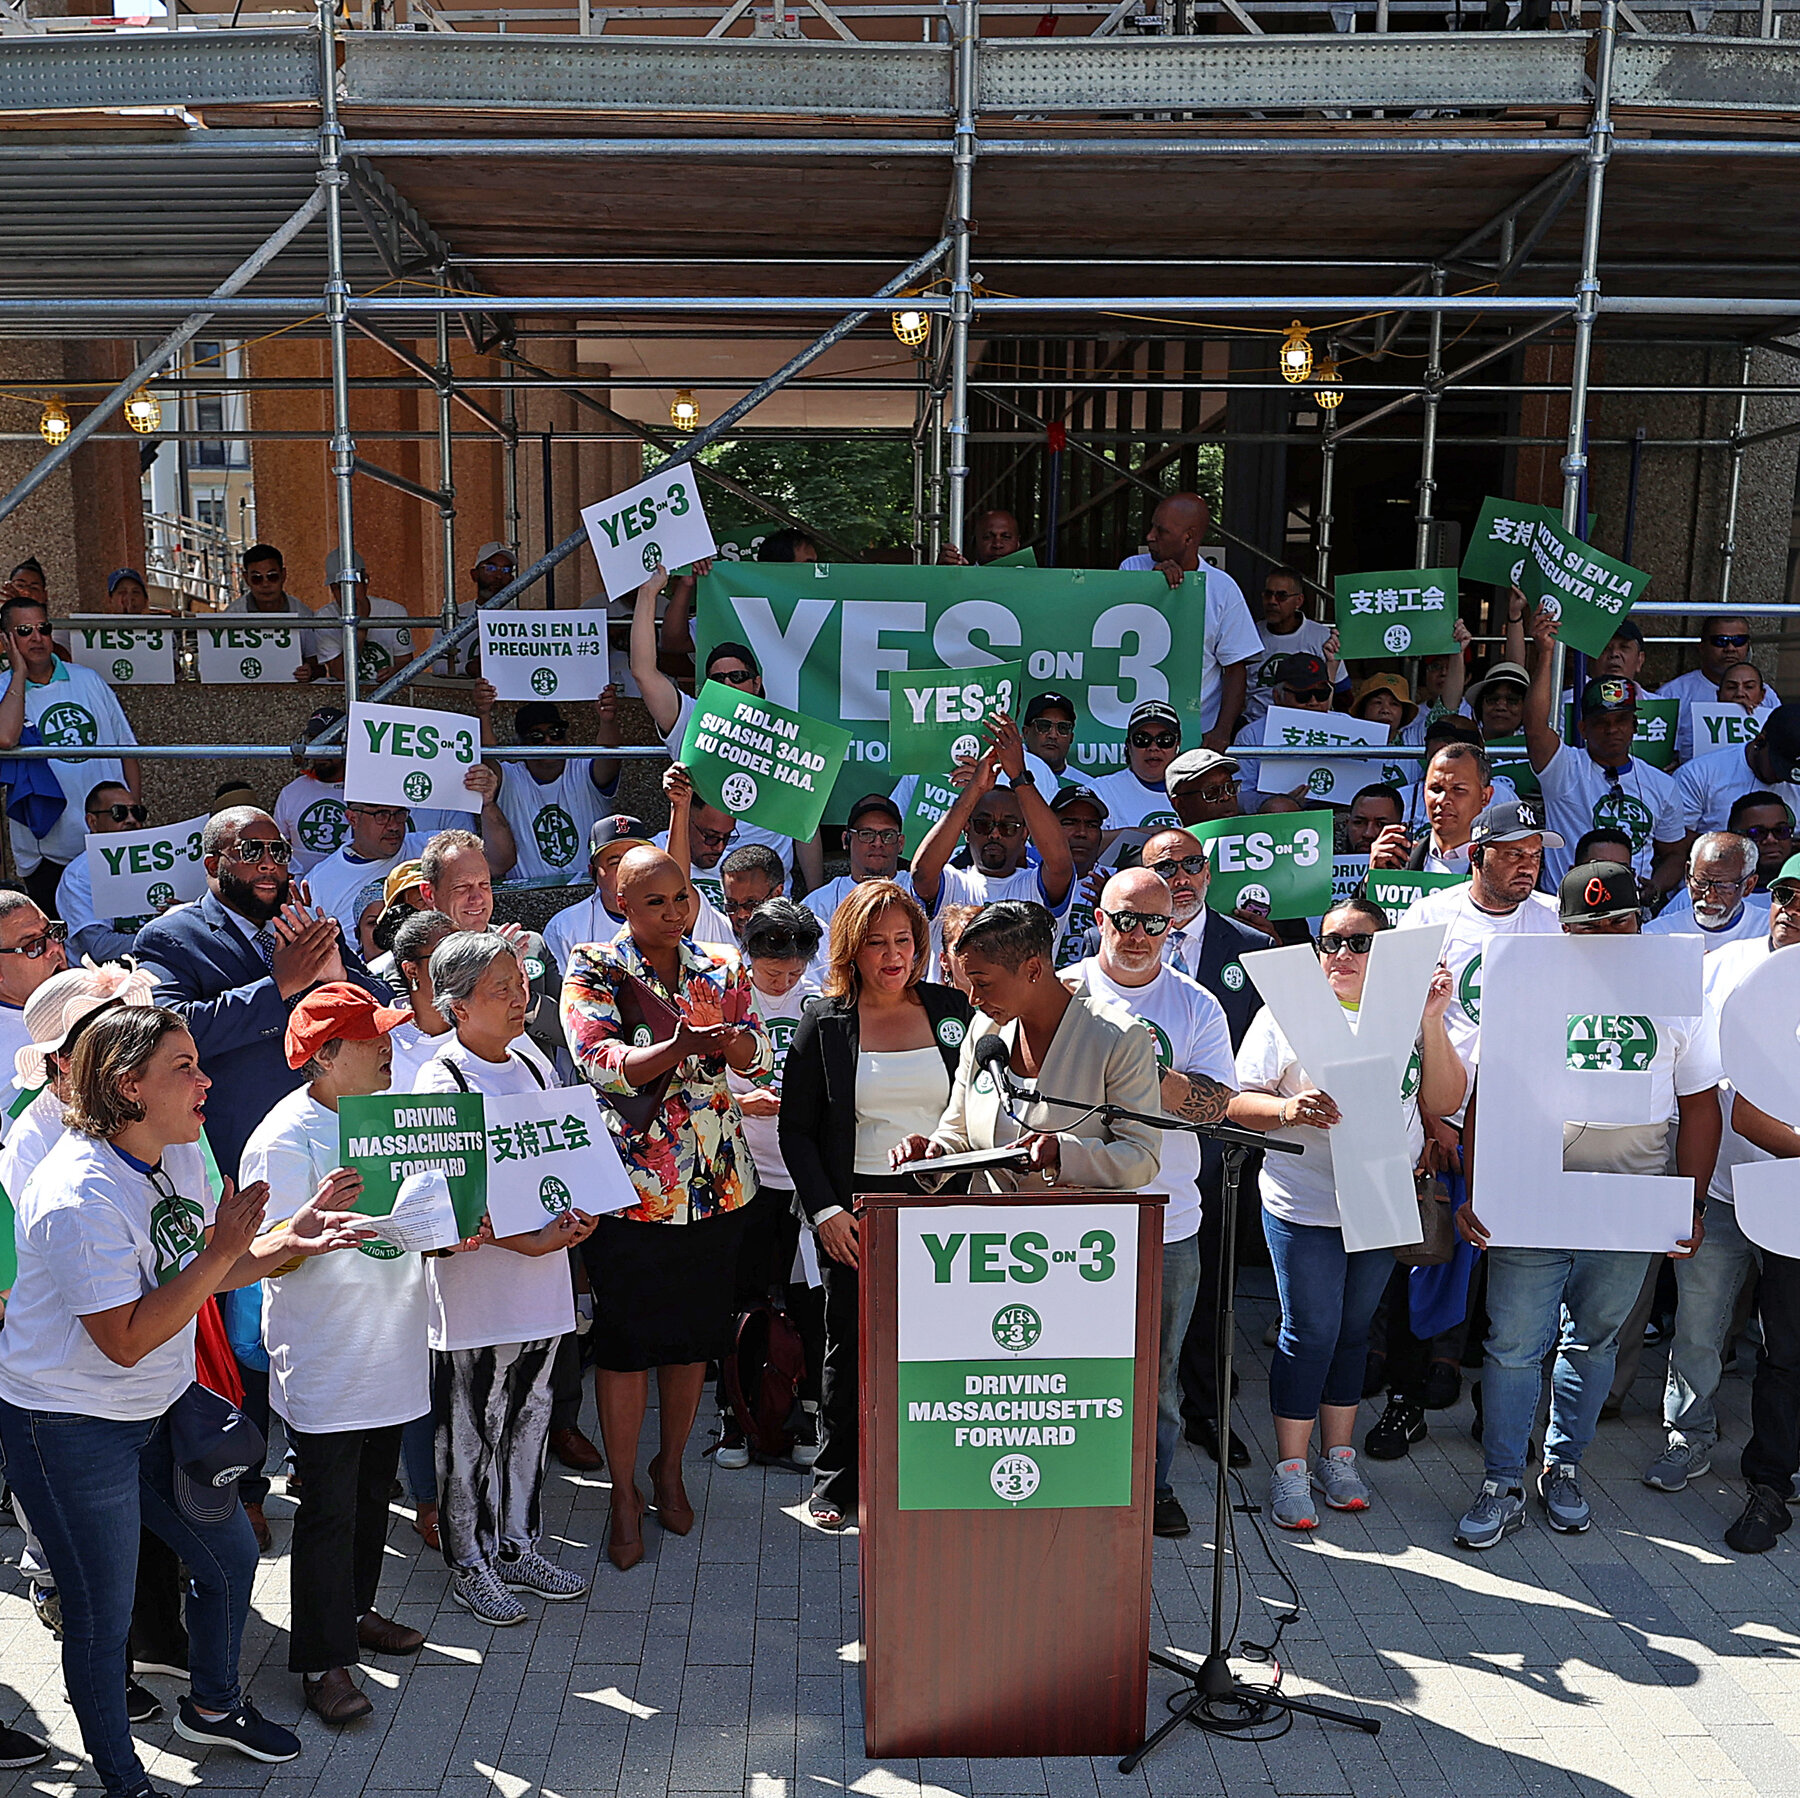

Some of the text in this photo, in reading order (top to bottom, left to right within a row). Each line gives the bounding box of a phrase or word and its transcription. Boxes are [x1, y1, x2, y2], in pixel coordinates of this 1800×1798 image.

[598, 483, 690, 548] YES ON 3
[1537, 520, 1633, 597] VOTA SI EN LA
[1531, 538, 1624, 614] PREGUNTA #3
[1349, 586, 1445, 615] 支持工会
[81, 629, 135, 651] YES
[149, 629, 164, 651] 3
[207, 629, 263, 649] YES
[274, 629, 292, 649] 3
[487, 623, 599, 638] VOTA SI EN LA
[489, 641, 600, 656] PREGUNTA #3
[729, 596, 1172, 730] YES ON 3
[903, 679, 1012, 724] YES ON 3
[49, 709, 83, 731] YES
[733, 703, 800, 741] FADLAN
[1703, 716, 1760, 744] YES
[363, 720, 474, 764] YES ON 3
[695, 733, 816, 792] KU CODEE HAA.
[777, 742, 826, 773] 3AAD
[924, 782, 960, 806] VOT
[313, 806, 343, 823] YES
[1600, 799, 1642, 821] YES
[319, 823, 334, 844] 3
[612, 816, 630, 835] B
[100, 832, 203, 876] YES ON 3
[1275, 844, 1293, 855] ON
[1293, 828, 1320, 867] 3
[1375, 884, 1423, 904] VOTA
[1070, 913, 1096, 934] ES
[1583, 1015, 1634, 1039] YES
[1596, 1040, 1623, 1070] 3
[394, 1106, 457, 1129] DRIVING
[348, 1131, 483, 1158] MASSACHUSETTS
[487, 1114, 592, 1164] 支持工会
[550, 1193, 563, 1209] 3
[920, 1229, 1116, 1284] YES ON 3
[1005, 1309, 1031, 1324] YES
[1010, 1324, 1024, 1341] 3
[965, 1373, 1067, 1396] DRIVING
[908, 1398, 1123, 1422] MASSACHUSETTS
[955, 1425, 1076, 1447] FORWARD
[1002, 1460, 1029, 1474] YES
[1009, 1475, 1022, 1491] 3
